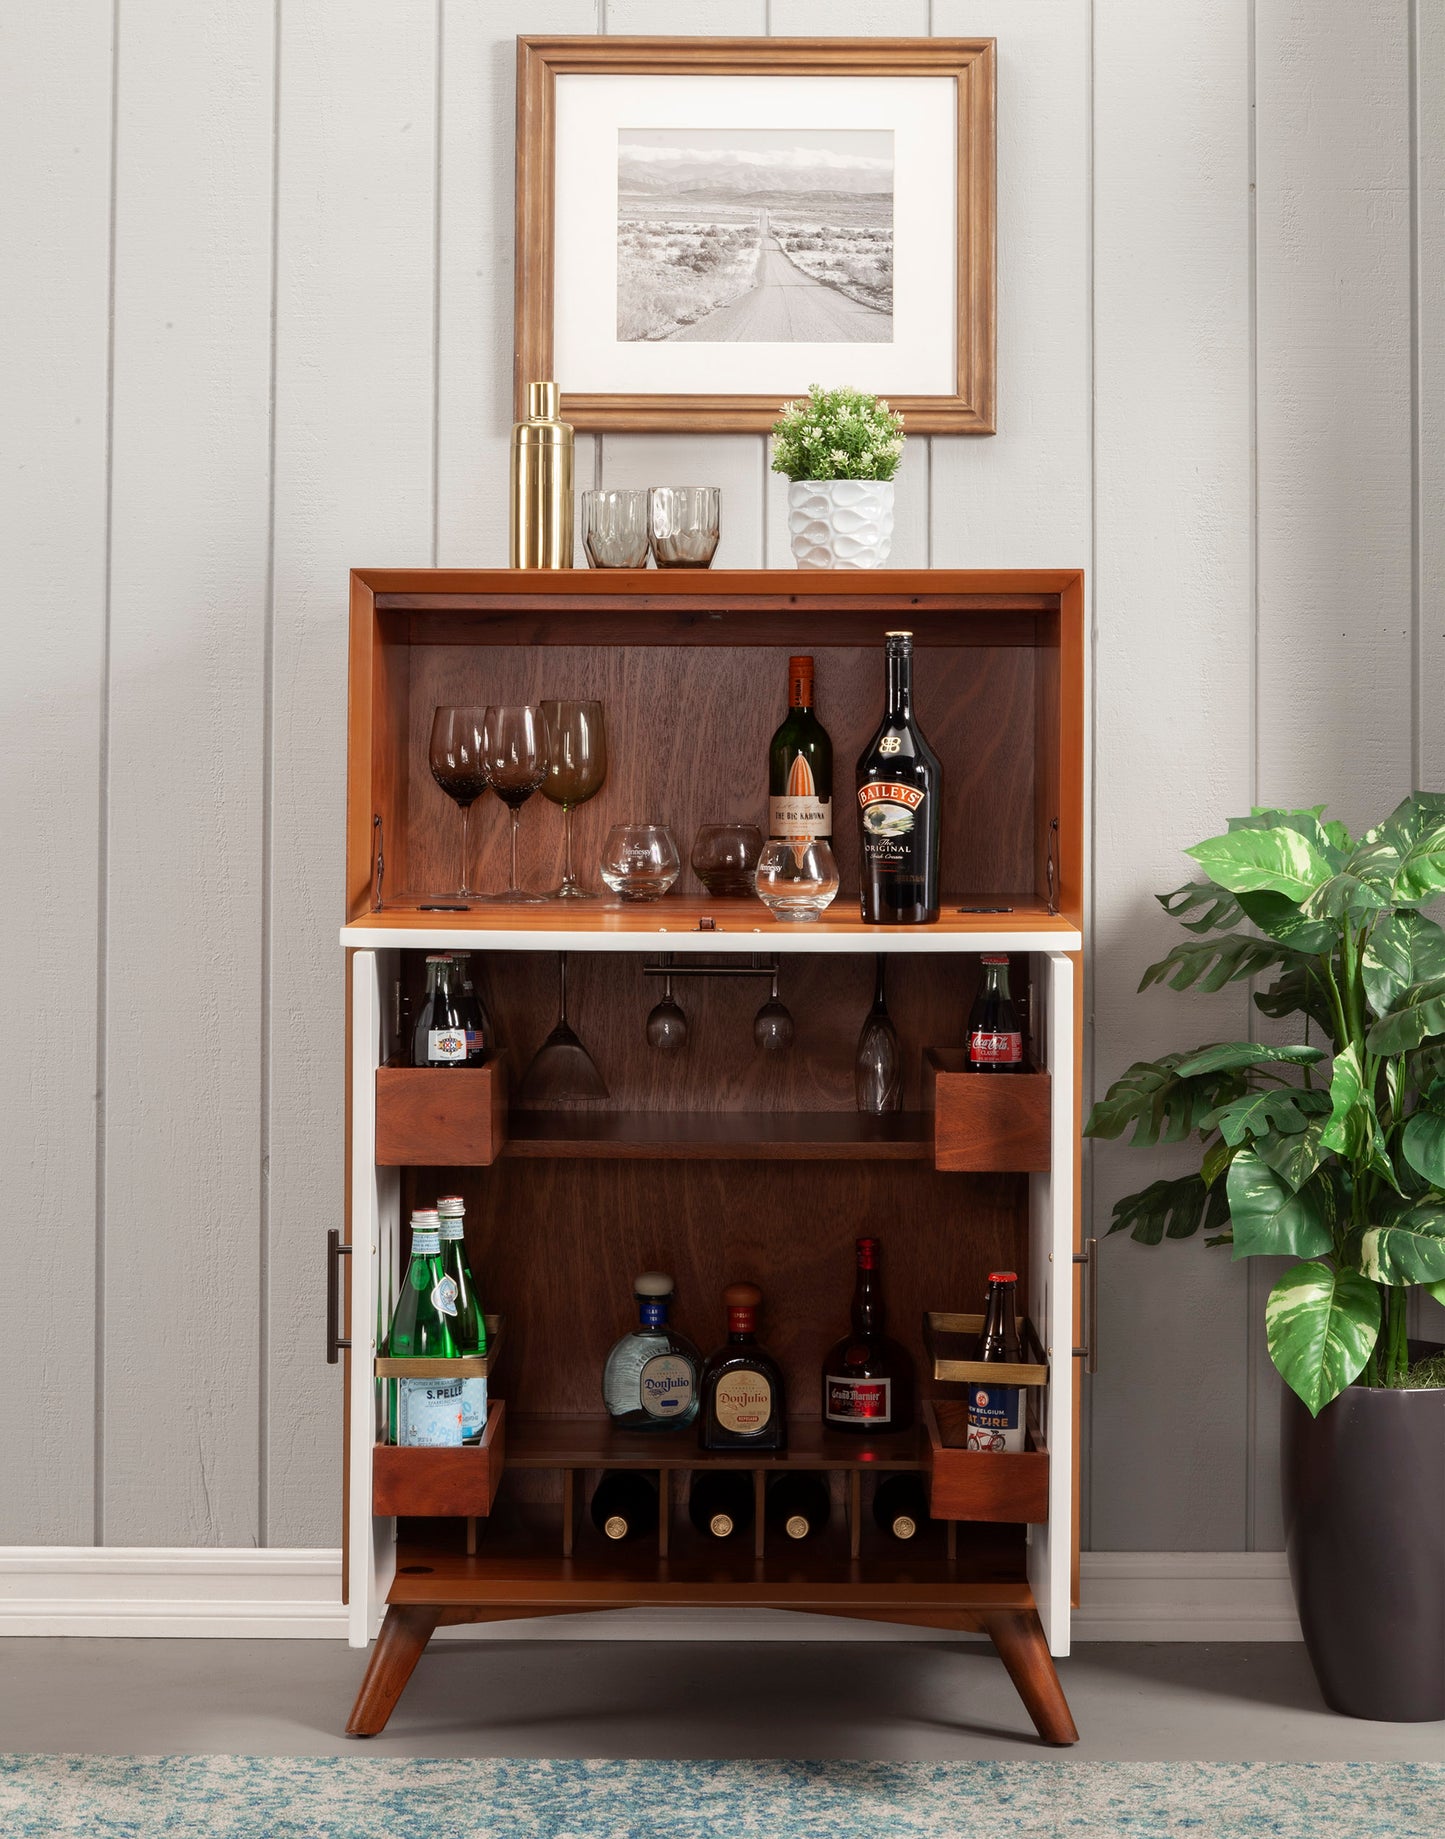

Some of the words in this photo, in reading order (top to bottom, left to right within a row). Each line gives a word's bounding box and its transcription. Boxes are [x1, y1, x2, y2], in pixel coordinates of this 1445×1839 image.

[860, 785, 920, 805] BAILEYS
[775, 811, 785, 820] THE
[878, 838, 894, 847] The
[622, 848, 652, 857] Hennessy
[864, 845, 912, 853] ORIGINAL
[980, 1416, 1009, 1427] TIRE
